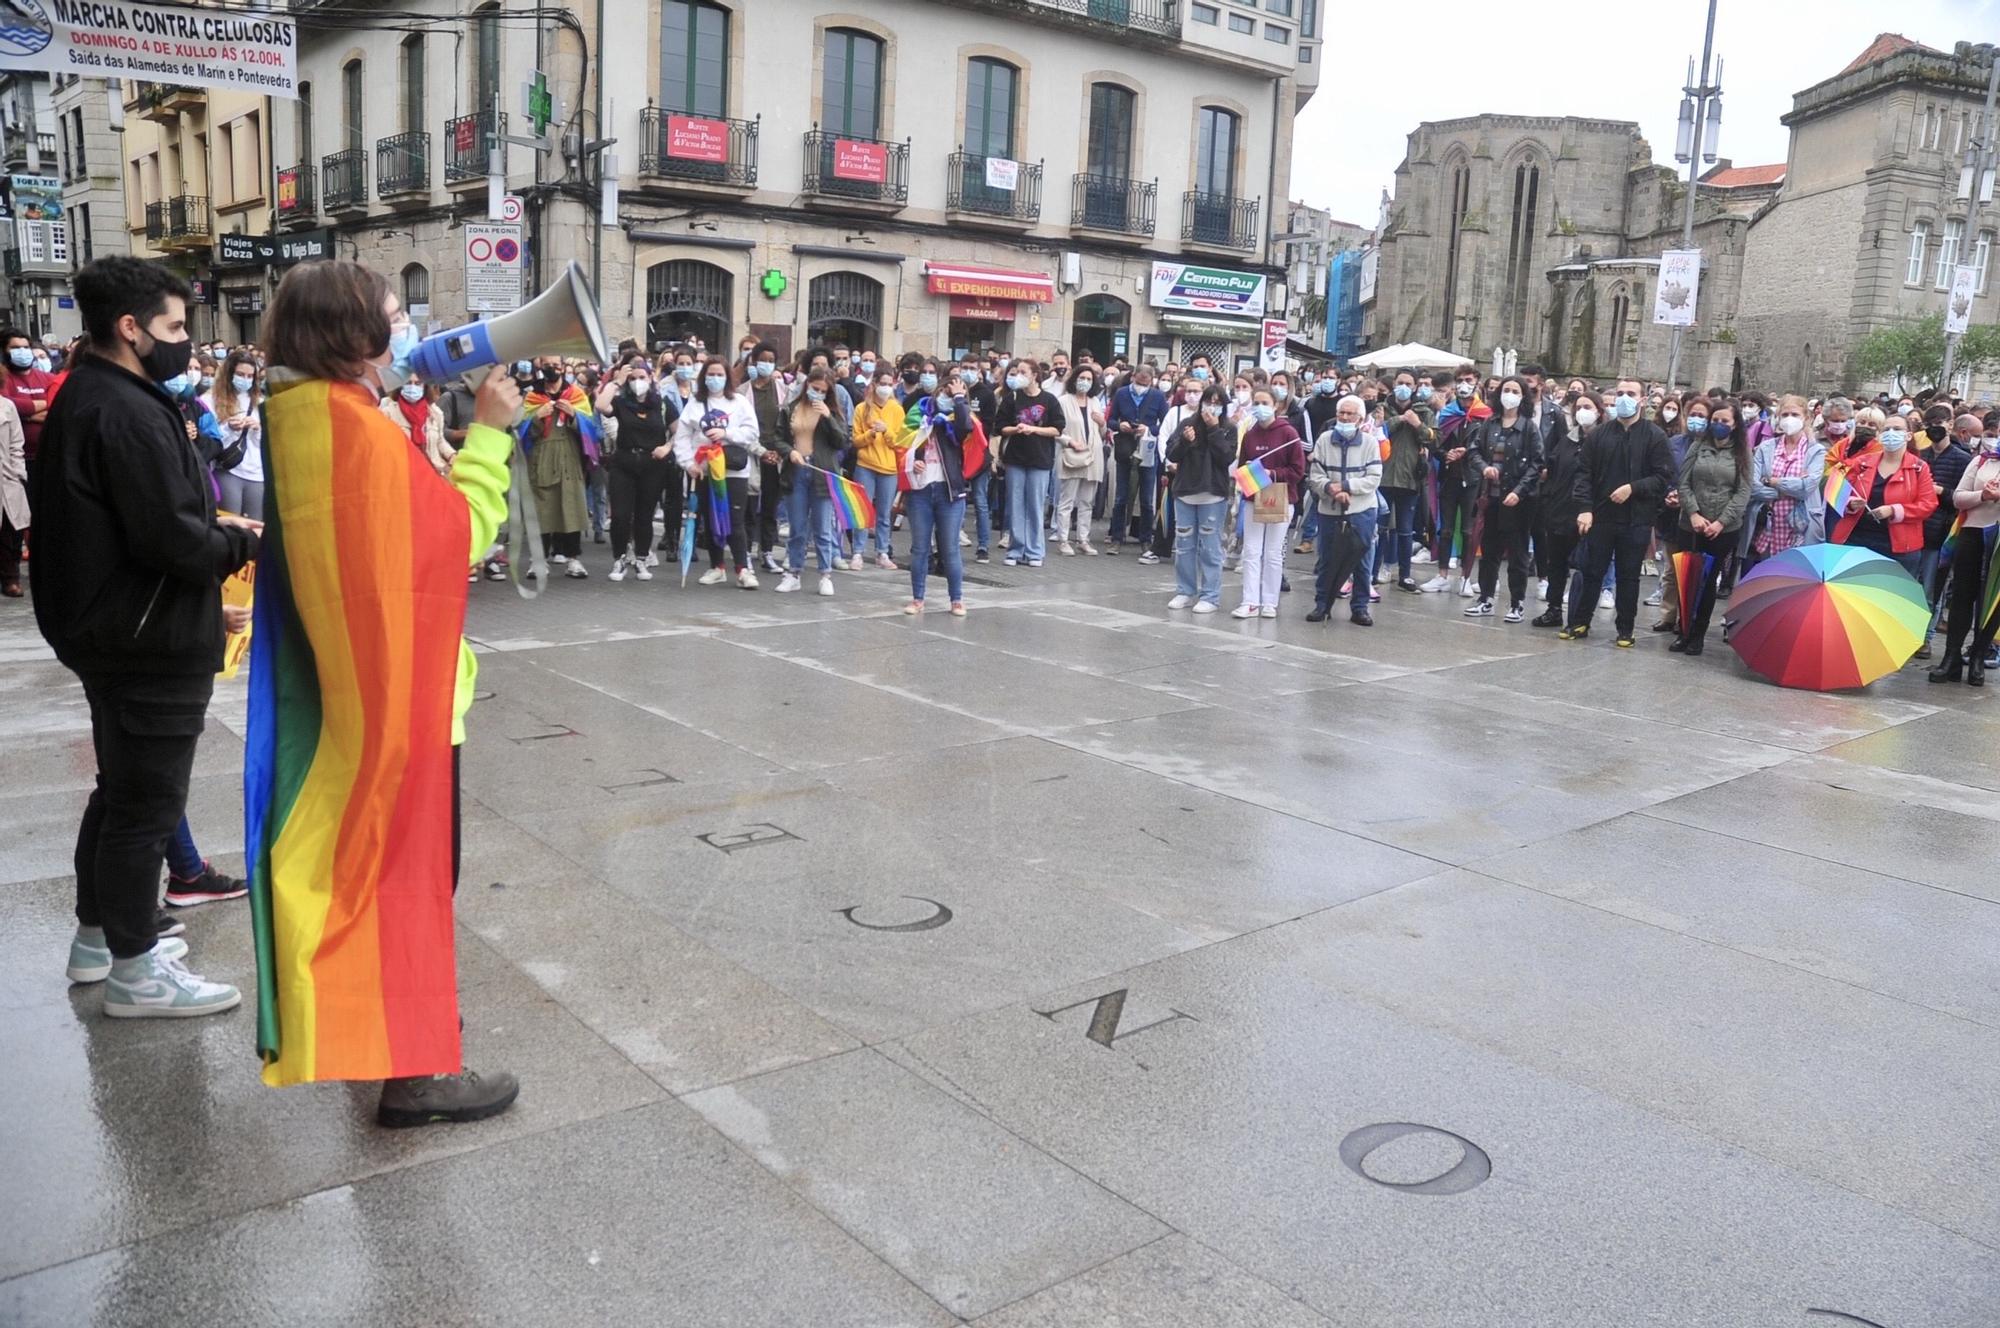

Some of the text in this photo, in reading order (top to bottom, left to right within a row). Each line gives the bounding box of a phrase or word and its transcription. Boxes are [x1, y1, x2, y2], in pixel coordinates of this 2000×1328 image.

[53, 0, 293, 47] MARCHA CONTRA CELULOSAS
[70, 31, 138, 51] DOMINGO
[142, 40, 150, 53] 4
[153, 41, 171, 55] DE
[175, 44, 217, 58] XULLO
[241, 49, 286, 67] 12.00H.
[104, 54, 124, 69] das
[127, 56, 180, 74] Alamedas
[182, 63, 195, 76] de
[229, 71, 235, 81] e
[237, 68, 292, 89] Pontevedra
[504, 205, 516, 214] 10
[468, 226, 489, 234] ZONA
[223, 238, 253, 249] Viajes
[223, 247, 253, 259] Deza
[1183, 271, 1229, 287] CENTRO
[1228, 277, 1254, 290] FUJI
[950, 282, 1028, 300] EXPENDEDURÍA
[1184, 288, 1210, 298] REVELADO
[965, 308, 998, 318] TABACOS
